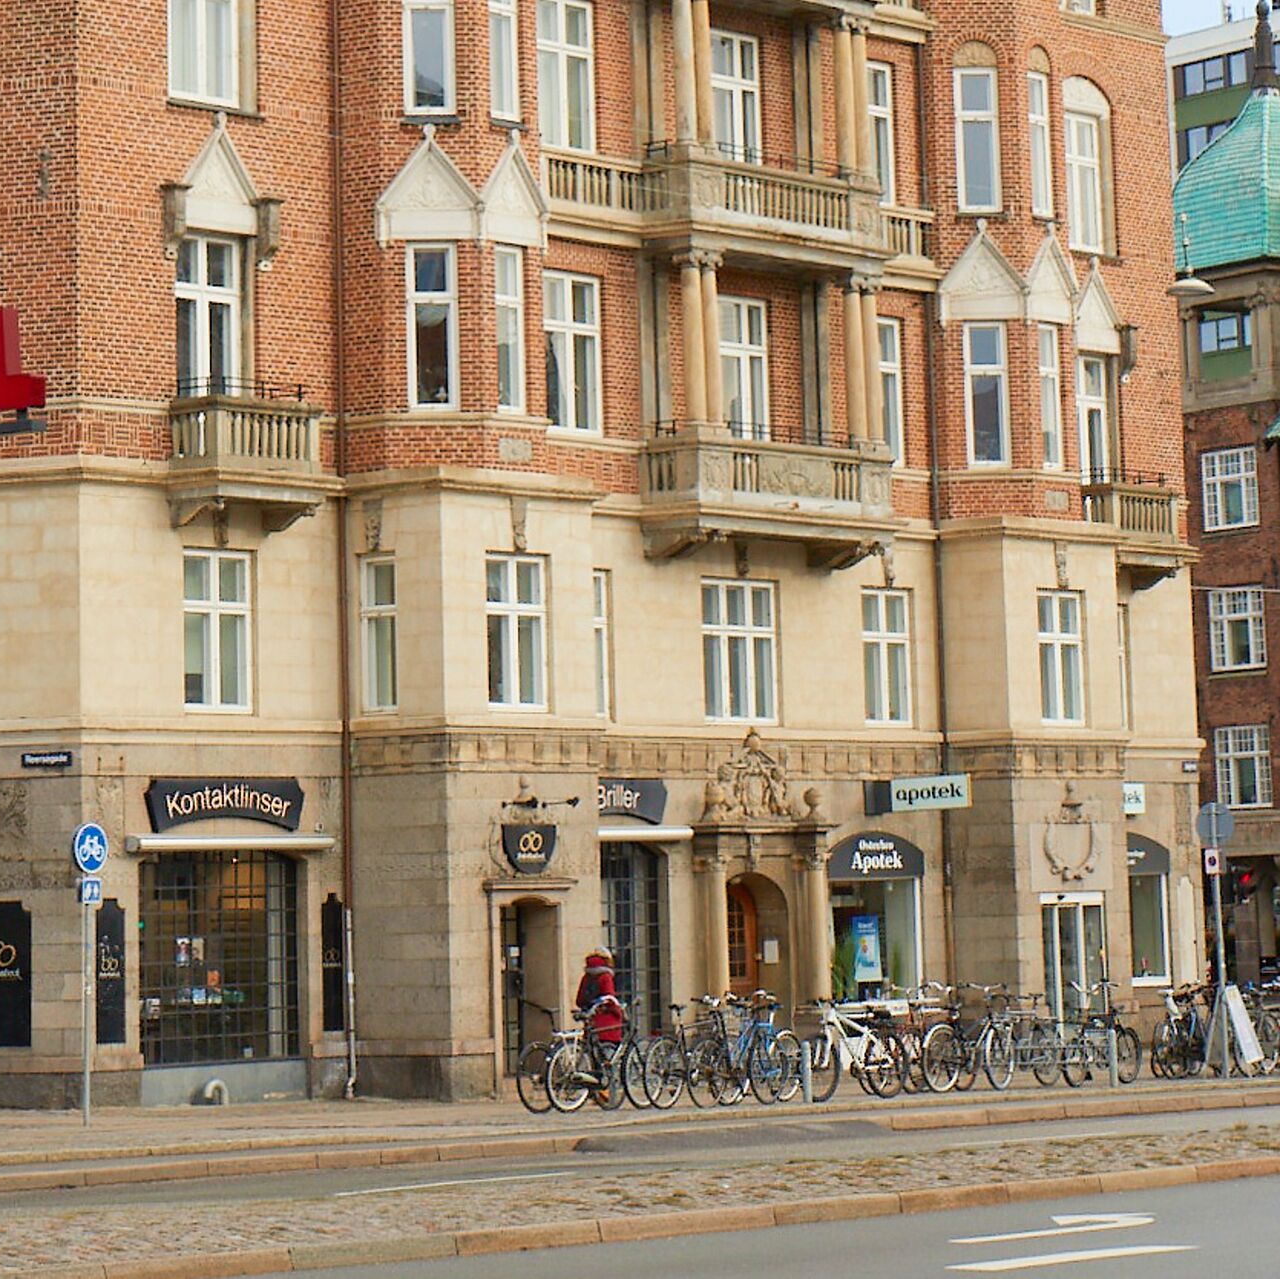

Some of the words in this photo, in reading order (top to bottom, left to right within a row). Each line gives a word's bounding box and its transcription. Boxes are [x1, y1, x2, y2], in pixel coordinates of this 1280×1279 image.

[166, 783, 291, 818] Kontaktlinser
[598, 784, 641, 809] Briller
[895, 783, 963, 805] apotek
[851, 851, 904, 874] Apotek
